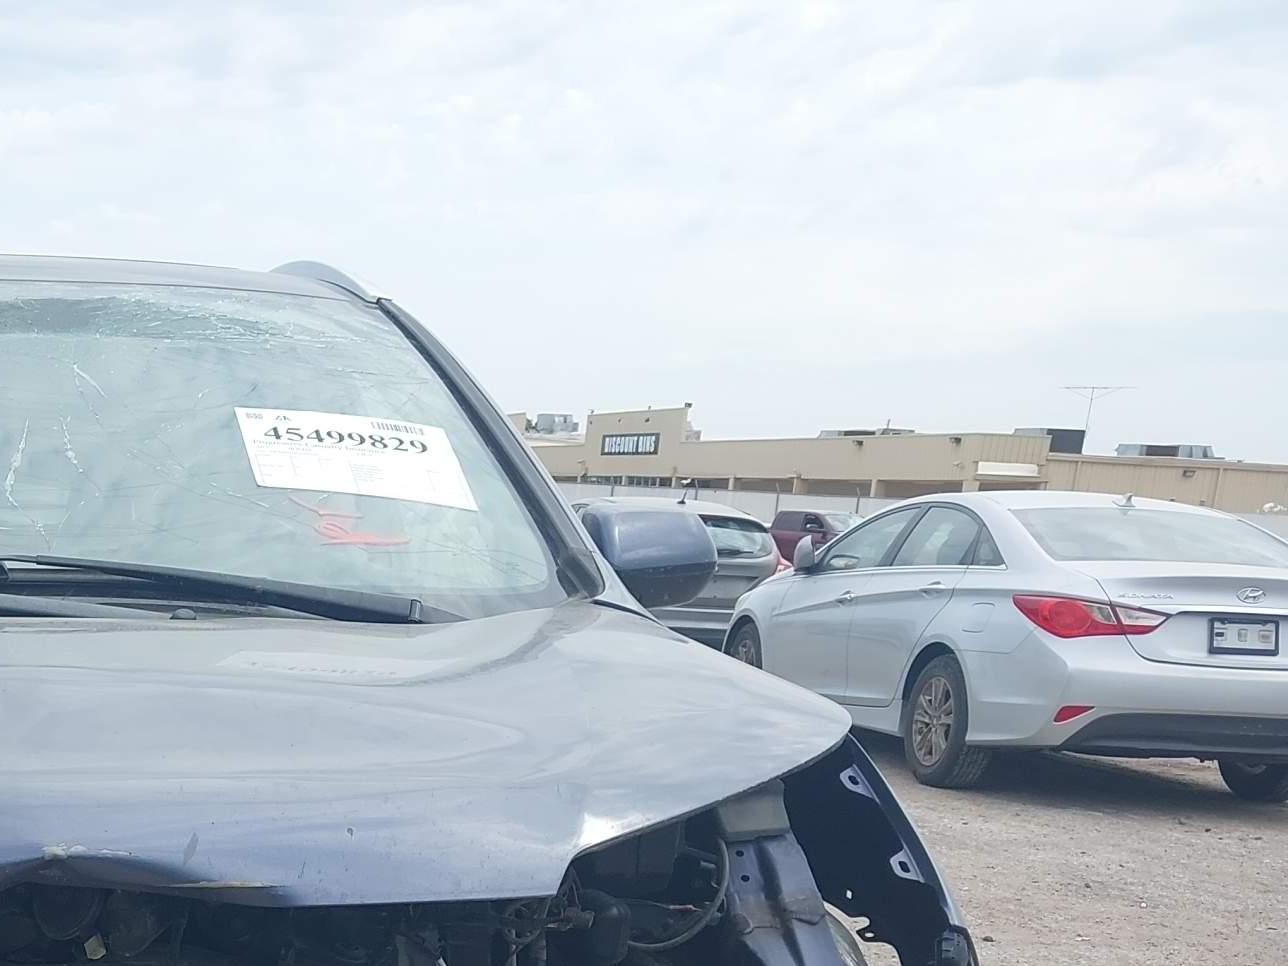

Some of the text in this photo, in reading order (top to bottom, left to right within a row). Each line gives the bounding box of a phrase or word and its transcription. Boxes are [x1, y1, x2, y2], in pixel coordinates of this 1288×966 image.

[263, 426, 429, 454] 45499829
[604, 435, 656, 453] DISCOUNT BINS
